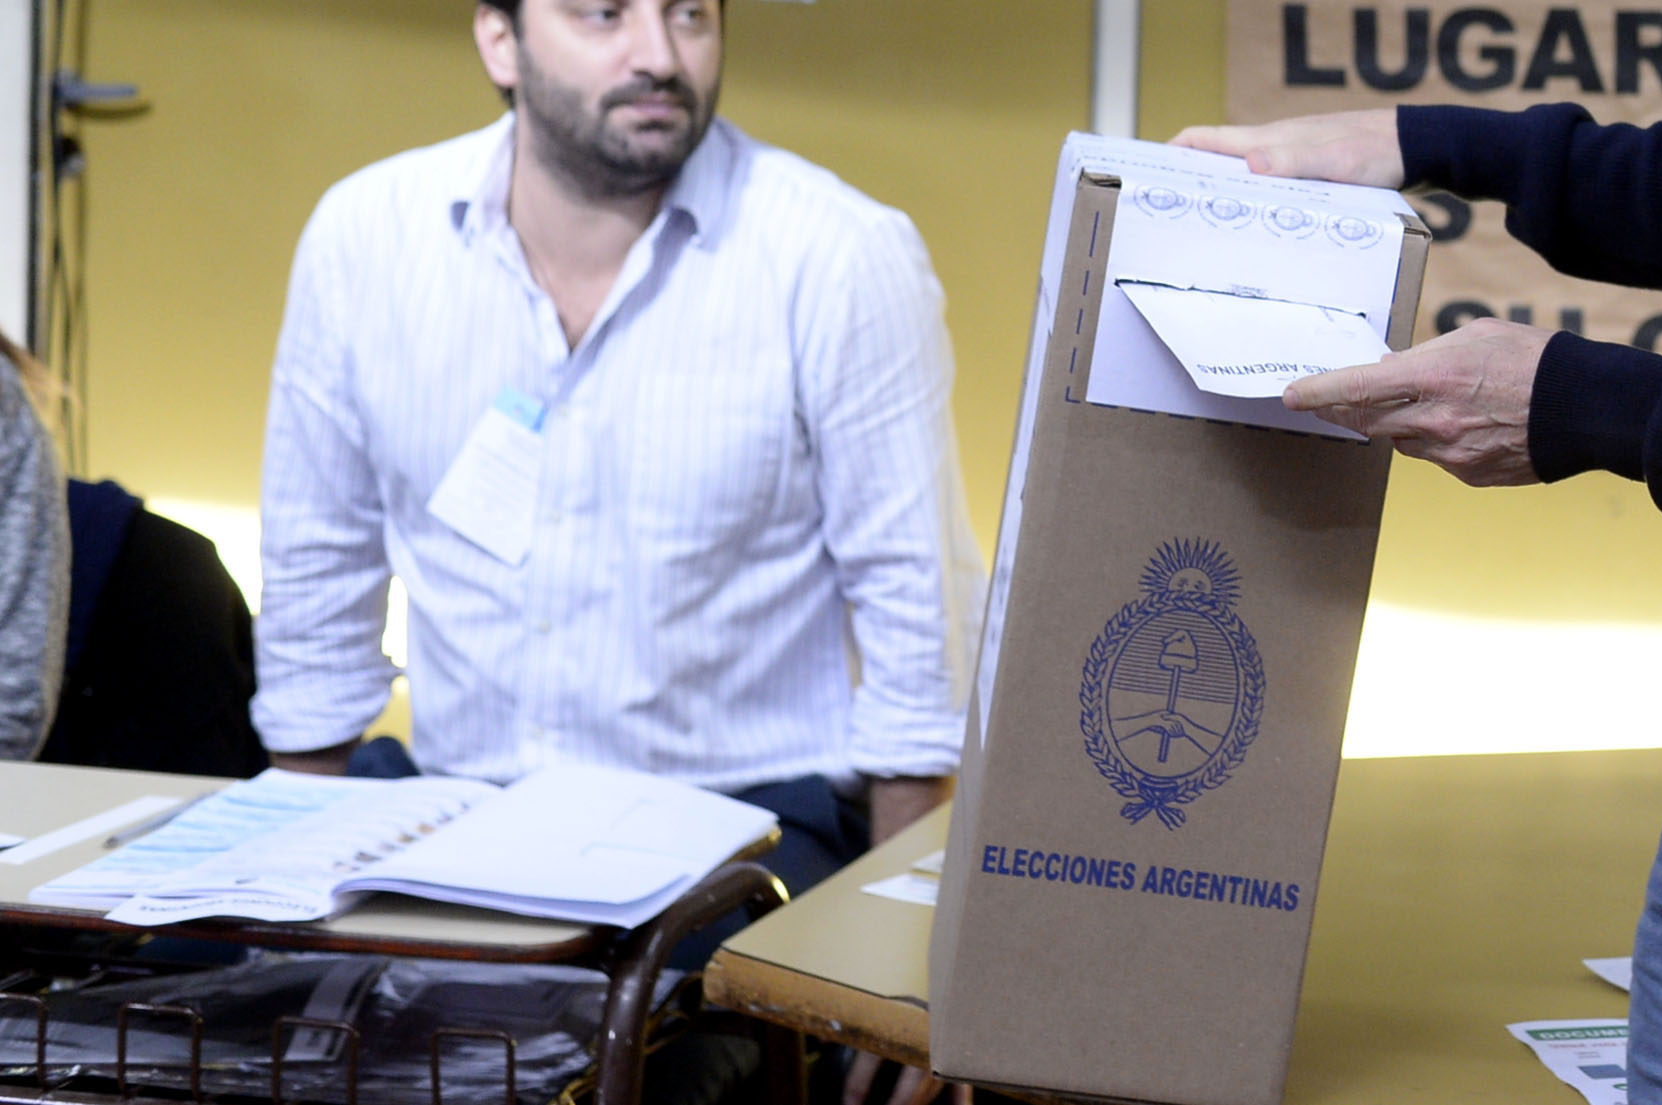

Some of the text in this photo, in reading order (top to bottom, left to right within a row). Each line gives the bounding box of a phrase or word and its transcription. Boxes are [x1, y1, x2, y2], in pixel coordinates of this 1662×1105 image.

[1197, 363, 1298, 375] ARGENTINAS
[982, 845, 1299, 911] ELECCIONES ARGENTINAS
[1540, 1028, 1629, 1039] DOCUME
